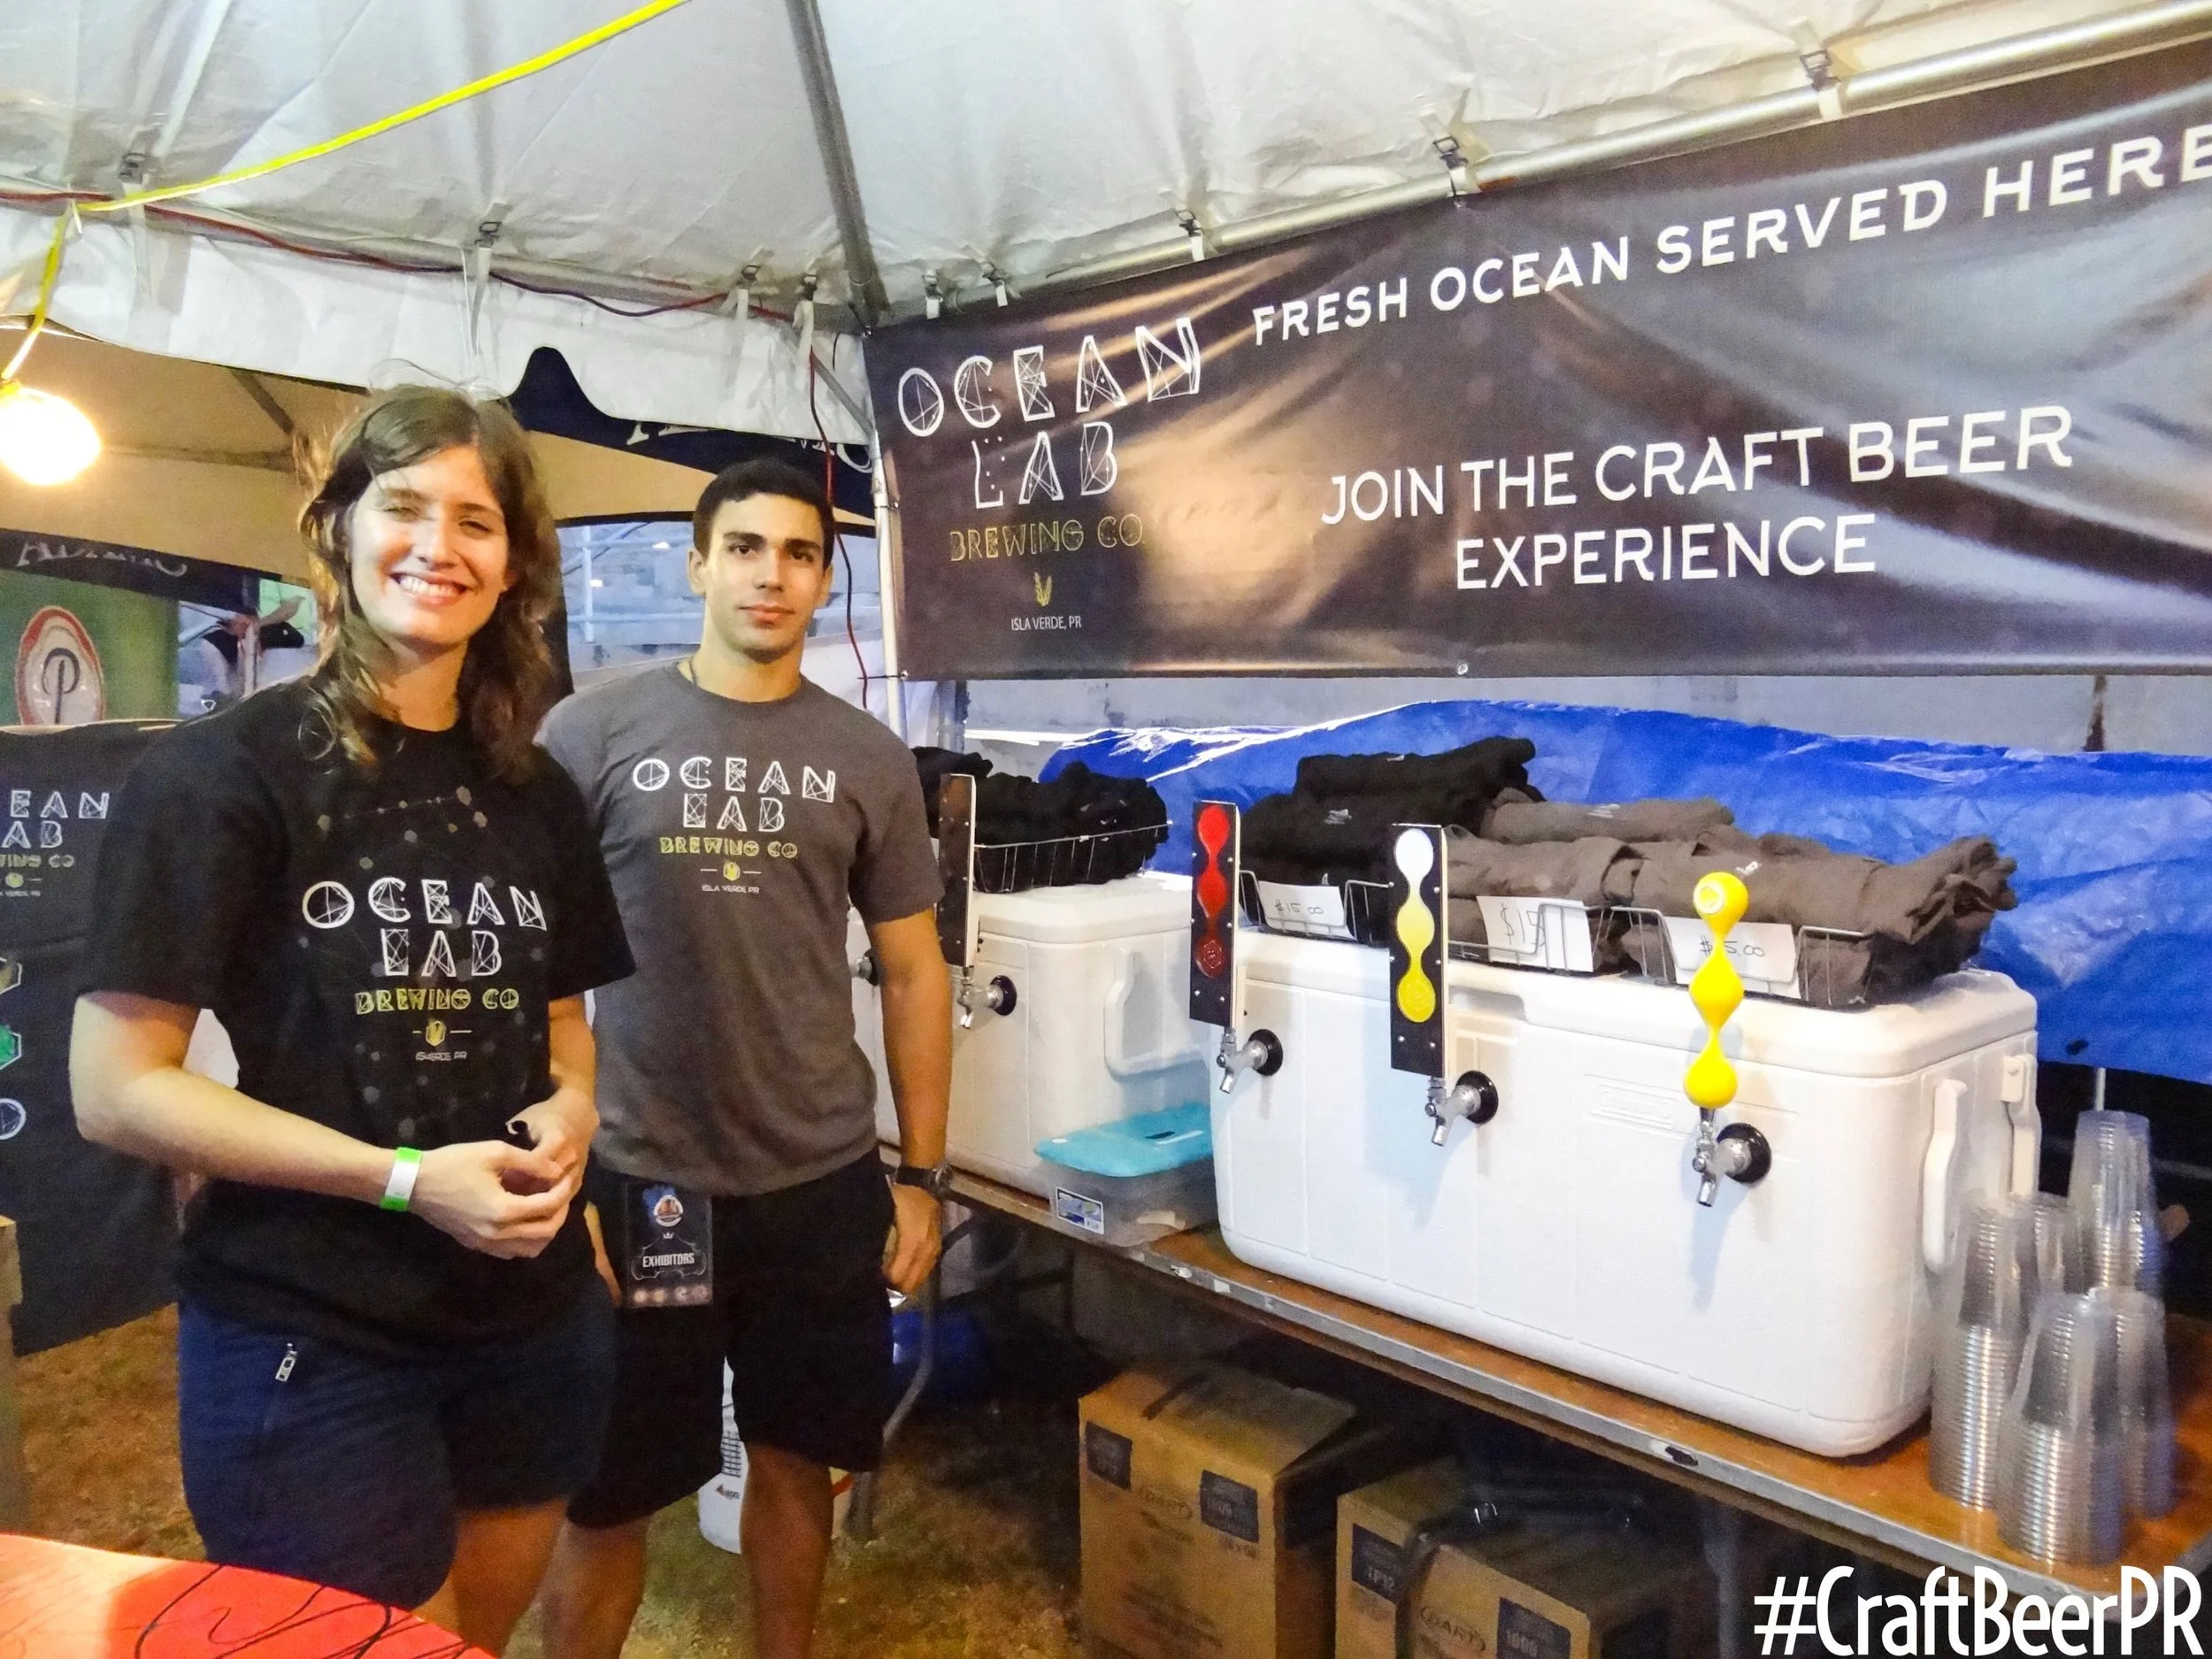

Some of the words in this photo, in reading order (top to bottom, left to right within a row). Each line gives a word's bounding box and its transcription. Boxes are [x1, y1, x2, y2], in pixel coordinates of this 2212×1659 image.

[1254, 275, 1409, 346] FRESH
[1430, 235, 1629, 312] OCEAN
[1656, 179, 1947, 274] SERVED
[1983, 124, 2212, 219] HERE
[897, 316, 1202, 437] OCEAN
[972, 420, 1118, 510] LAB
[1321, 464, 1446, 526] JOIN
[1461, 450, 1578, 510] THE
[1594, 425, 1825, 503] CRAFT
[1847, 404, 2073, 483] BEER
[949, 519, 1084, 562] BREWING
[1454, 513, 1877, 590] EXPERIENCE
[1010, 617, 1031, 631] ISLA
[1068, 614, 1082, 629] PR
[632, 756, 836, 803] OCEAN
[10, 788, 110, 819] EAN
[682, 793, 786, 833] LAB
[1, 820, 64, 849] AB
[659, 836, 760, 856] BREWING
[302, 876, 548, 932] OCEAN
[380, 927, 503, 978] LAB
[354, 988, 472, 1015] BREWING
[642, 1253, 695, 1267] EXHIBITORS
